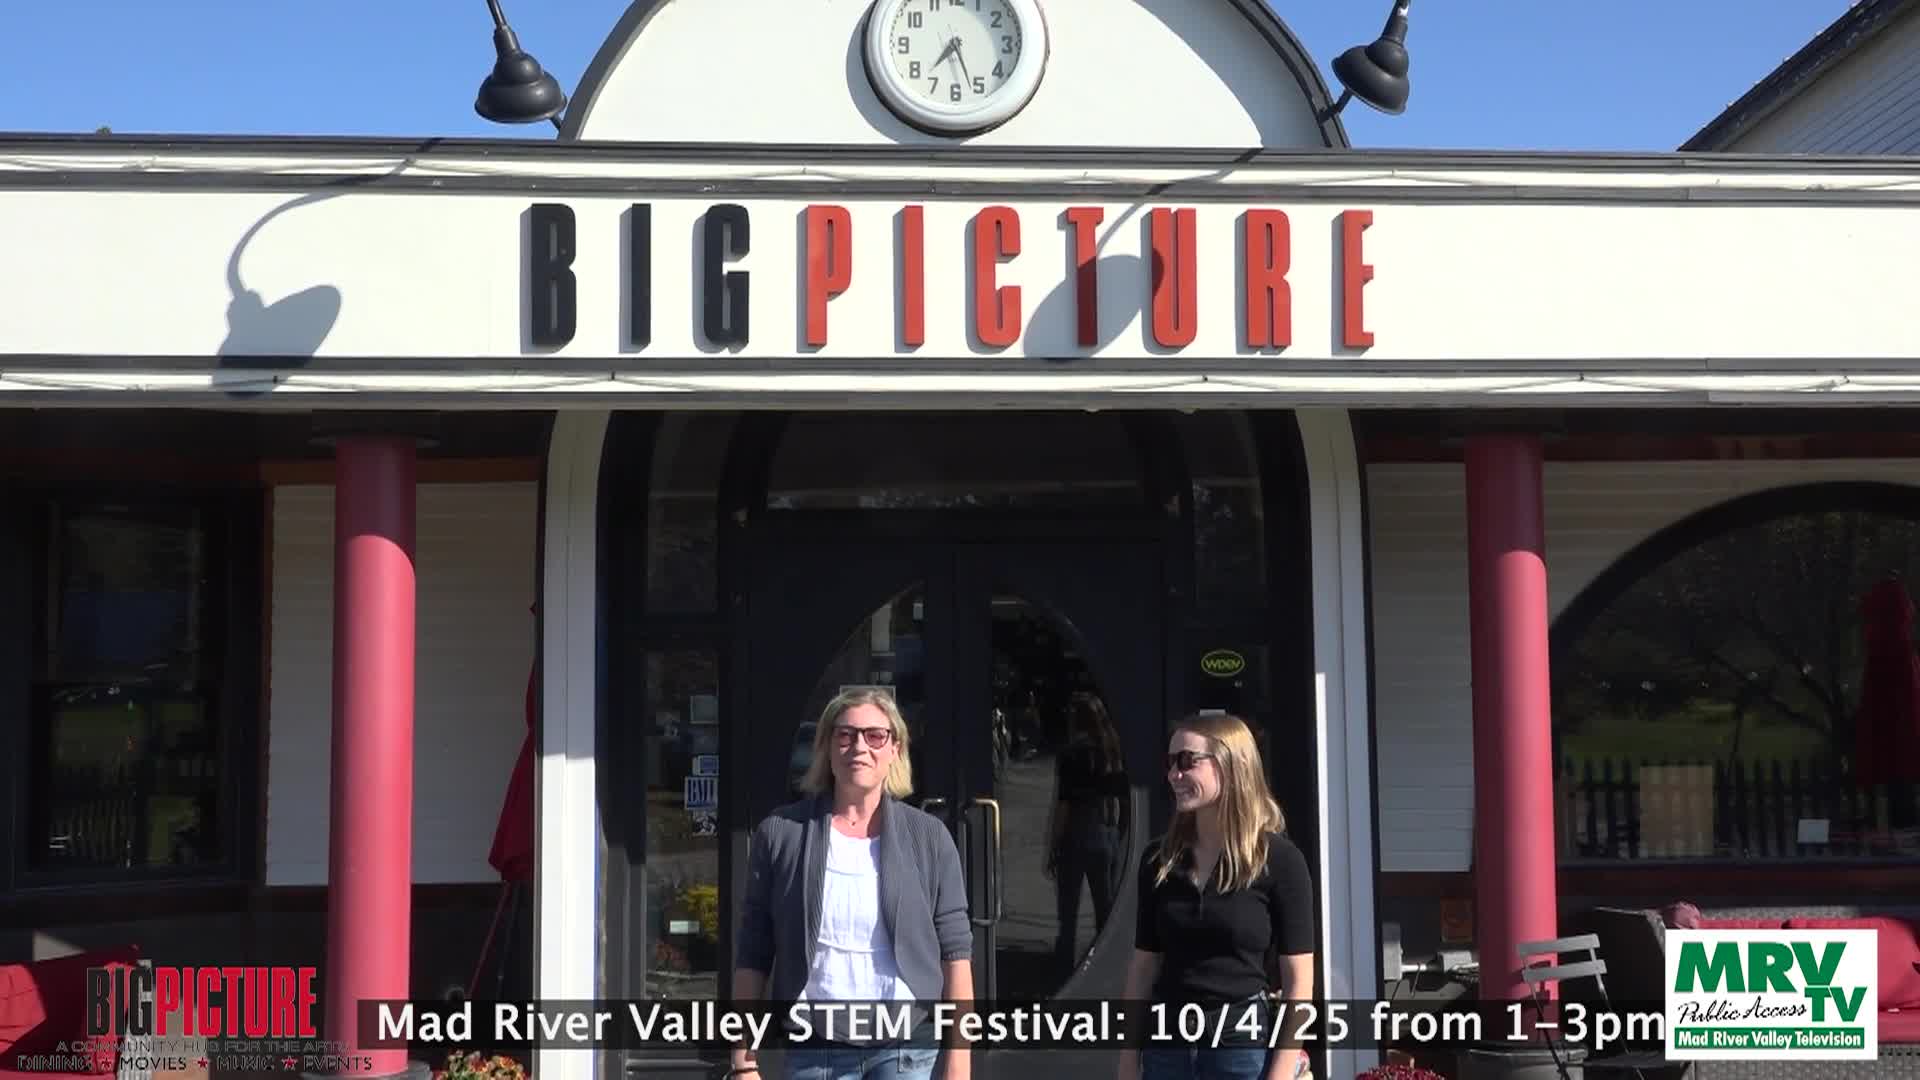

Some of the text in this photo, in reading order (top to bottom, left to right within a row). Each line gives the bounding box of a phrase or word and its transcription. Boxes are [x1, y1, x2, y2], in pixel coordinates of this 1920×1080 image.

[908, 12, 922, 28] 10
[991, 11, 1001, 28] 2
[898, 37, 909, 54] 9
[1002, 36, 1013, 54] 3
[909, 61, 920, 79] 8
[992, 60, 1003, 79] 4
[928, 77, 938, 94] 7
[950, 83, 961, 101] 6
[973, 77, 985, 94] 5
